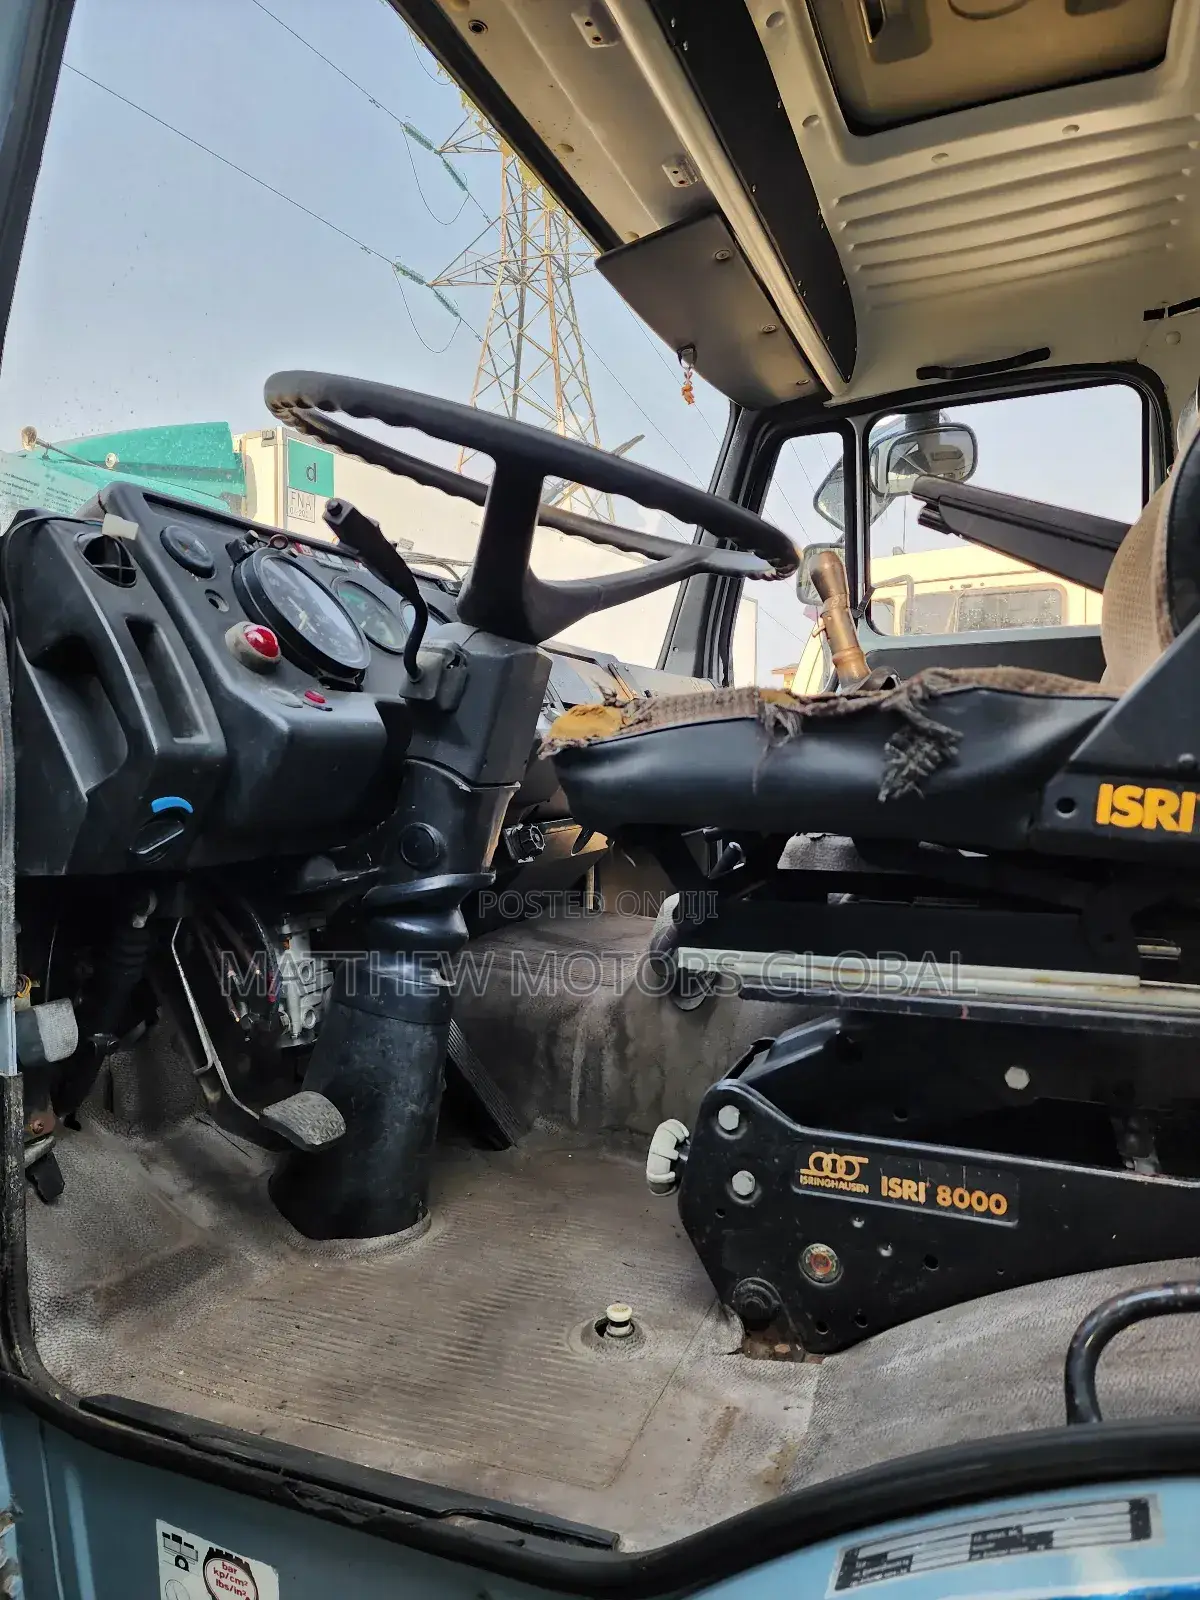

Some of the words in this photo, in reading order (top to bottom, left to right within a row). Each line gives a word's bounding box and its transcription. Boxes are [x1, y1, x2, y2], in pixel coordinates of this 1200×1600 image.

[306, 462, 317, 483] d
[291, 491, 312, 511] FNA
[1095, 783, 1197, 834] ISRI
[800, 1174, 869, 1194] ISRINGHAUSEN
[880, 1175, 927, 1205] ISRI
[936, 1184, 1008, 1216] 8000
[221, 1561, 238, 1574] bar
